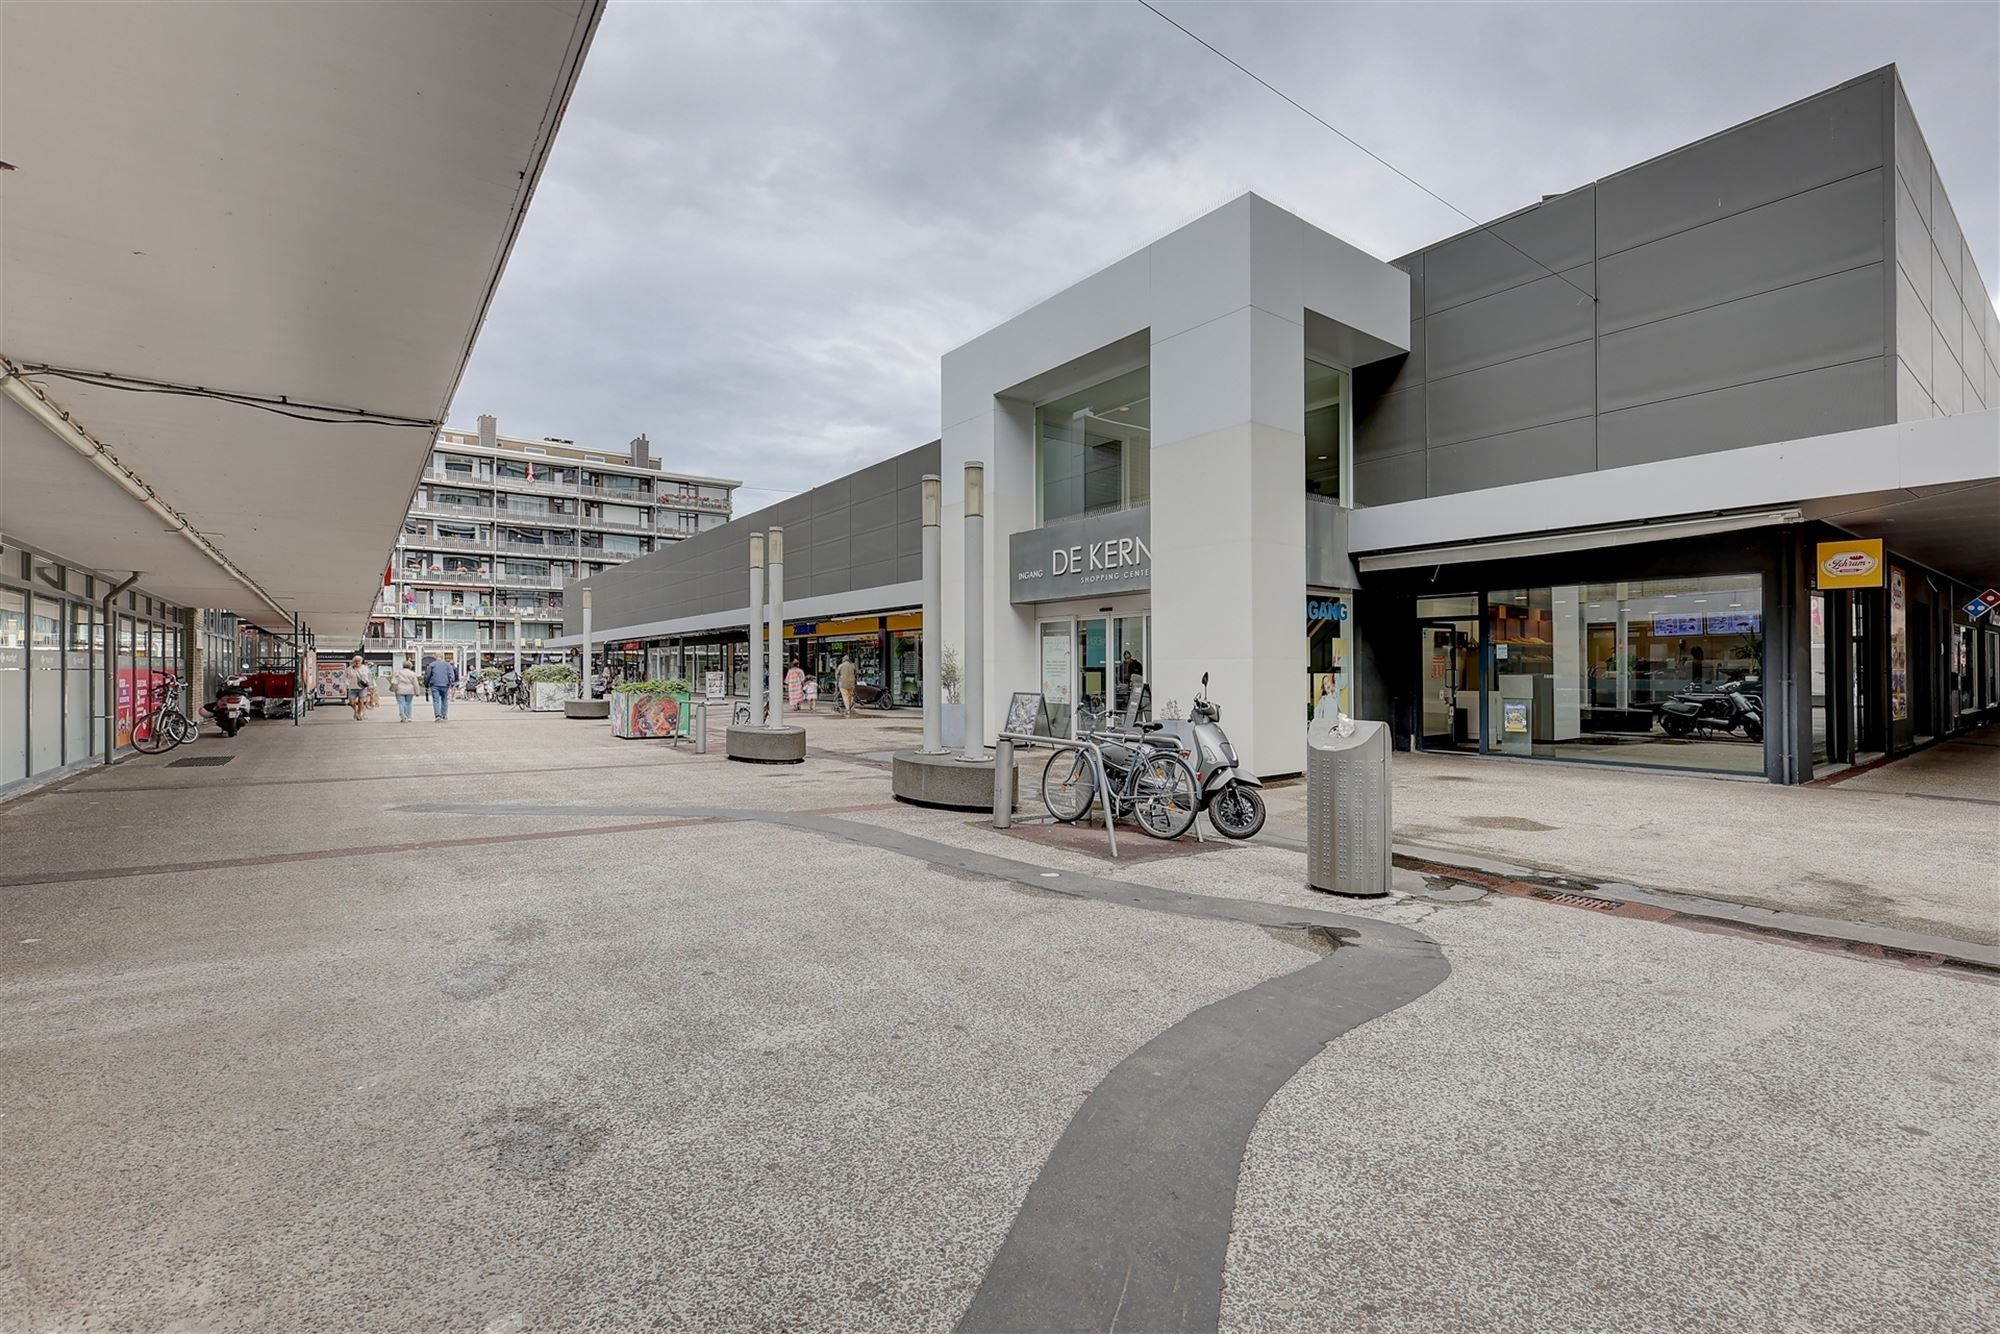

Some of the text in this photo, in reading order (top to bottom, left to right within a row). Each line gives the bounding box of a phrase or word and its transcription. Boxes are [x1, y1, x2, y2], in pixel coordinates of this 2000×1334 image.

[1052, 536, 1151, 575] DE KERN
[1018, 570, 1044, 580] INGANG
[1080, 569, 1151, 584] SHOPPING CENTE
[1306, 600, 1350, 623] GANG
